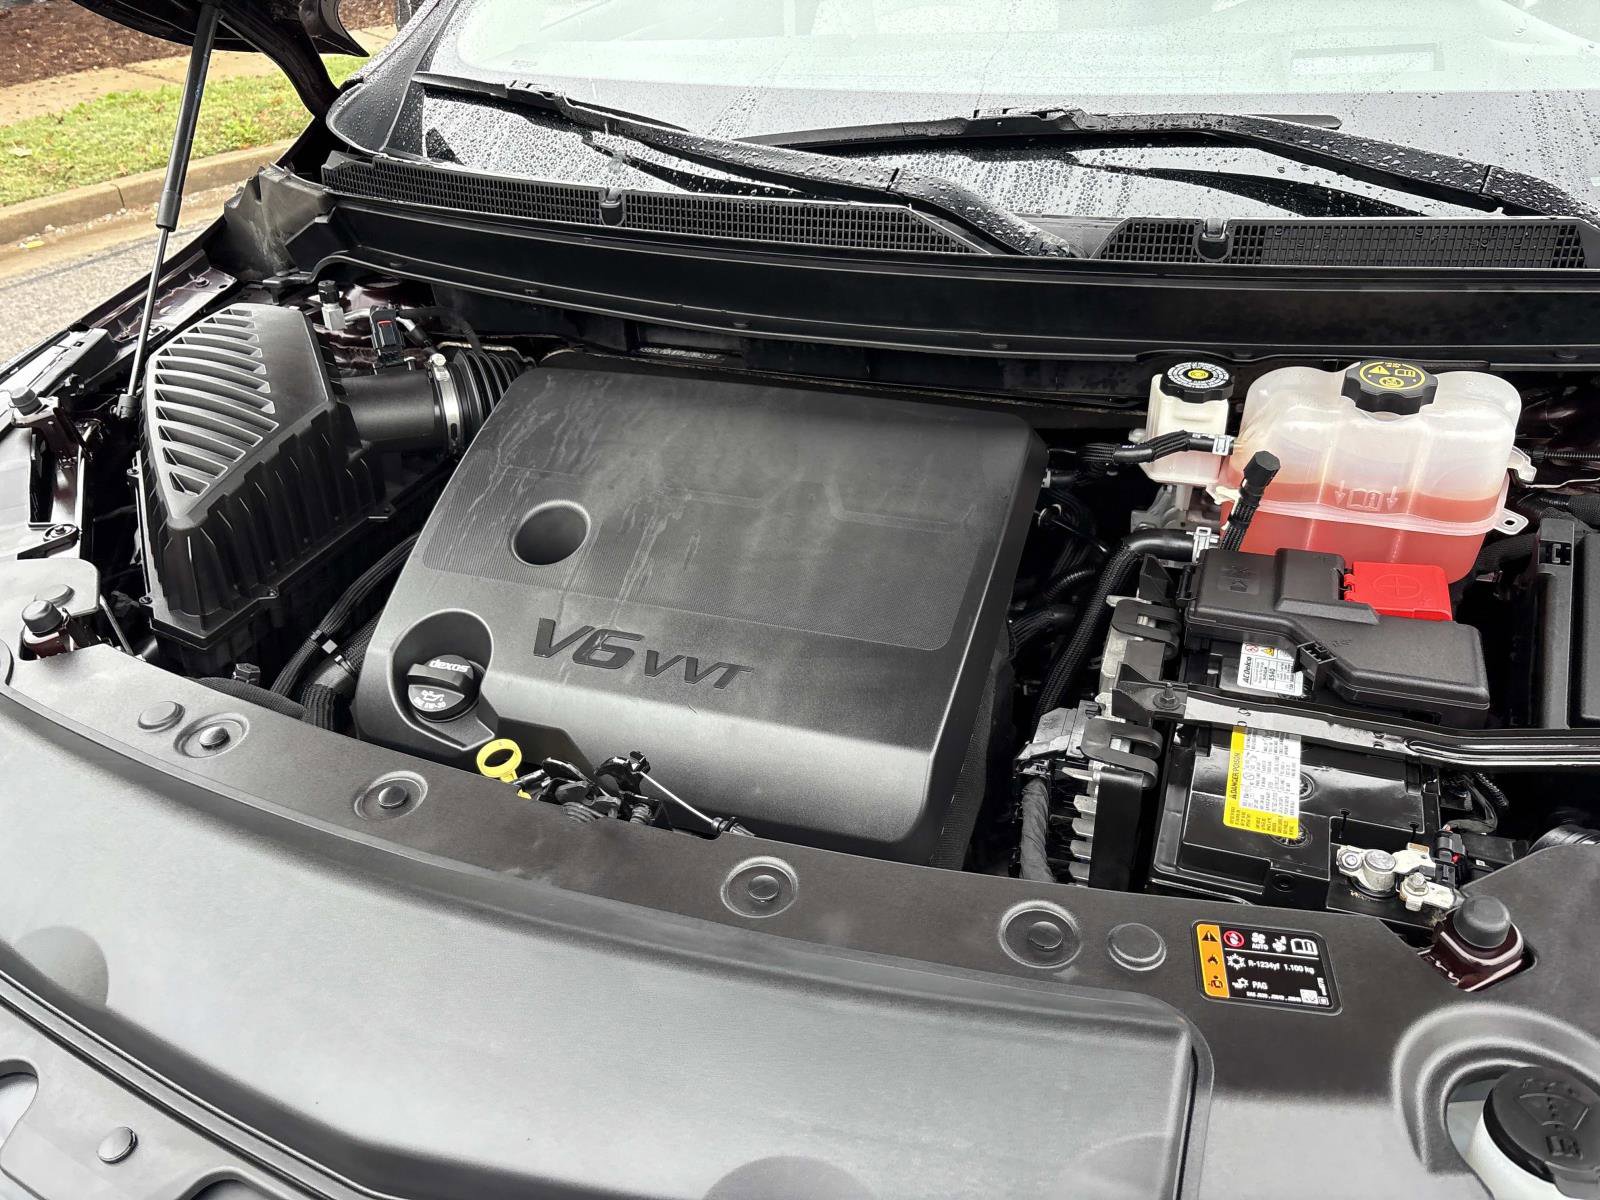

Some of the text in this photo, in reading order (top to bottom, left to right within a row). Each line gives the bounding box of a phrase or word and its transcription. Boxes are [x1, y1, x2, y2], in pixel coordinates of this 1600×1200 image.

[533, 617, 754, 690] V6 VVT
[428, 659, 471, 673] dexos
[1252, 943, 1269, 951] AUTO
[1248, 959, 1315, 975] R-1234yf 1.100 kg
[1252, 980, 1268, 990] PAG
